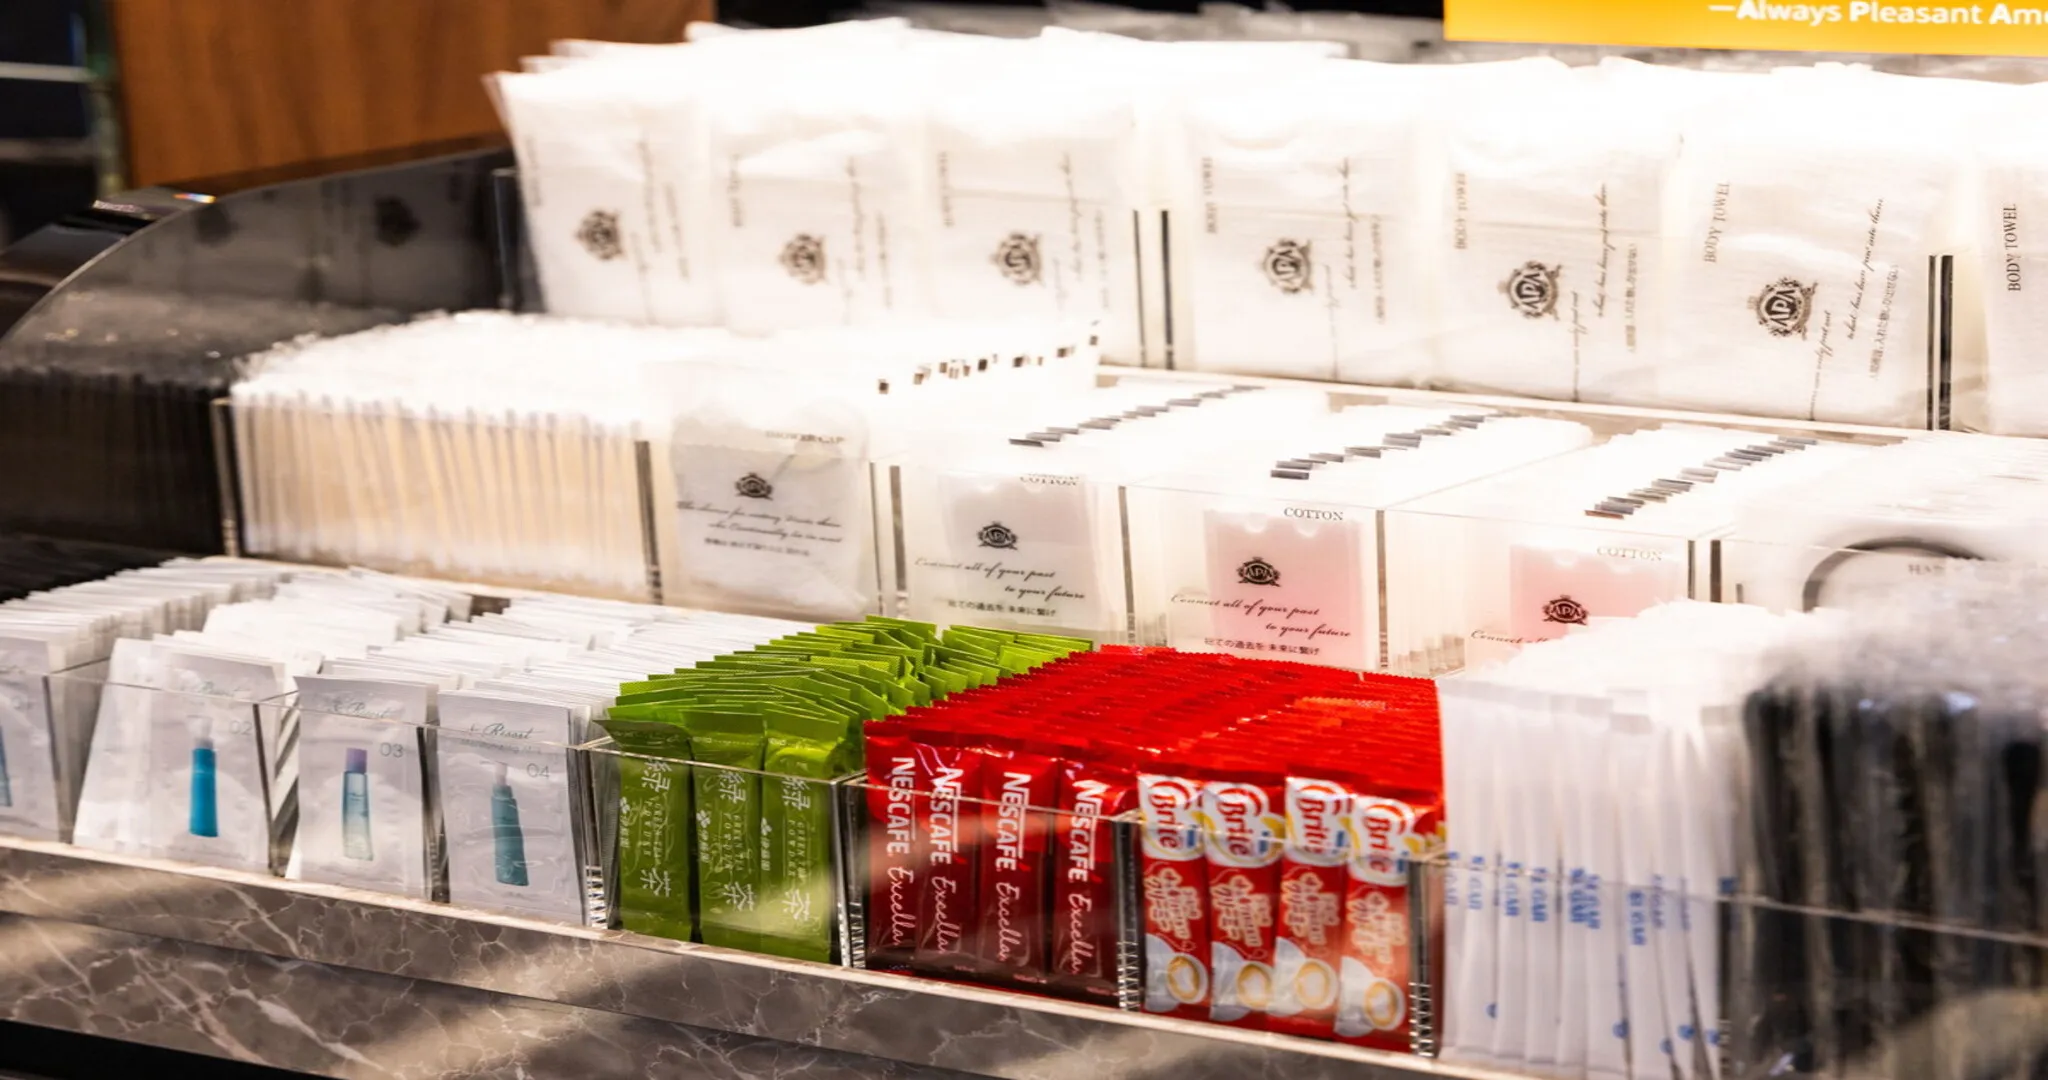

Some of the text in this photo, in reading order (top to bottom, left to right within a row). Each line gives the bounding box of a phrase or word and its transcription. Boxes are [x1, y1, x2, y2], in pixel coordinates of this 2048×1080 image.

[1849, 1, 1982, 24] Pleasant
[1453, 218, 1468, 250] BODY
[1702, 181, 1732, 263] BODY TOWEL
[2003, 204, 2022, 292] BODY TOWEL
[1284, 507, 1344, 521] COTTON
[1596, 547, 1663, 561] COTTON
[964, 562, 981, 571] all
[984, 561, 1001, 578] of
[996, 567, 1026, 580] your
[1023, 570, 1056, 582] past
[1004, 585, 1086, 602] to your future
[1170, 594, 1320, 619] Connect all of your past
[1266, 622, 1351, 640] to your future
[1470, 629, 1523, 644] Connect
[229, 719, 253, 736] 02
[380, 742, 404, 758] 03
[526, 763, 550, 779] 04
[641, 758, 673, 792] 緑
[719, 769, 746, 804] 緑
[782, 776, 811, 811] 緑
[1150, 792, 1179, 850] Brite
[1216, 799, 1251, 857] Brite
[787, 819, 797, 877] POWDER
[797, 821, 806, 857] GREEN
[1363, 815, 1392, 875] Brie
[640, 868, 671, 898] 茶
[722, 881, 755, 912] 茶
[782, 888, 810, 921] 茶
[887, 866, 916, 946] Excella
[932, 876, 960, 954] Excella
[996, 882, 1023, 962] Excella
[1068, 893, 1095, 975] Excella
